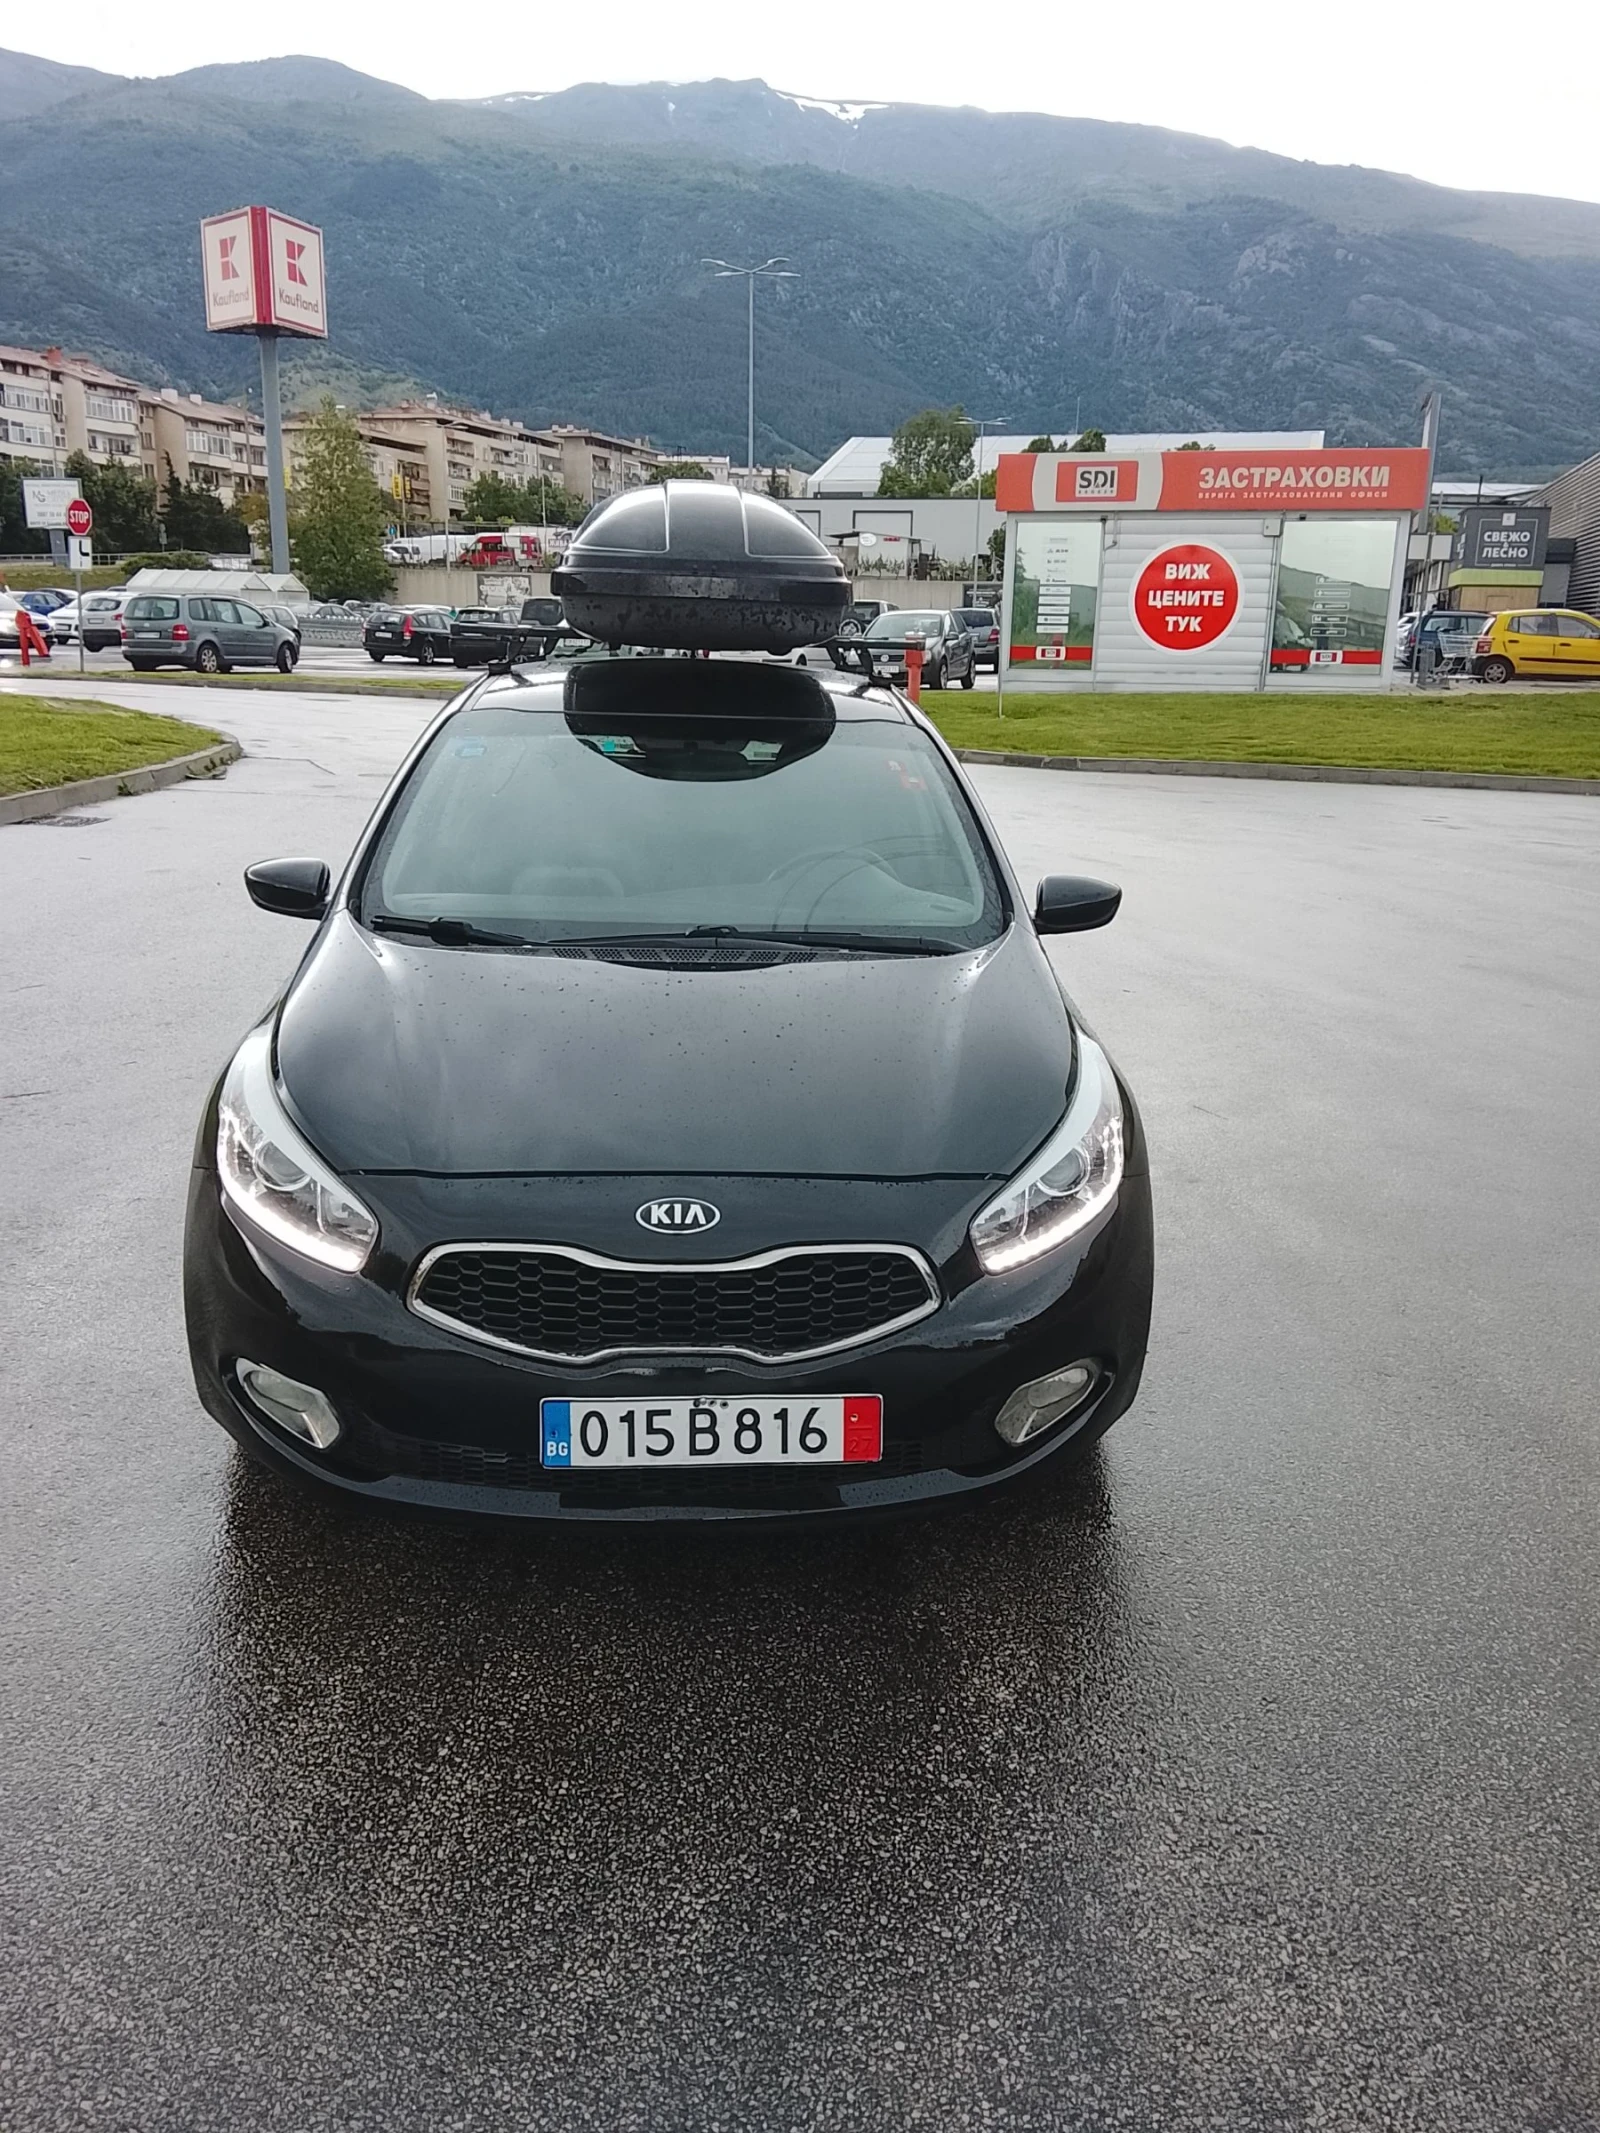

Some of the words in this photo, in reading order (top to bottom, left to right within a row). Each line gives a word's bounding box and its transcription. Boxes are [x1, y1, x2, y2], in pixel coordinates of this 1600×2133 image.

[219, 235, 240, 281] K
[285, 239, 308, 287] K
[212, 287, 250, 307] Kaufland
[278, 287, 320, 313] Kaufland
[1079, 470, 1115, 488] SDI
[1198, 466, 1390, 489] ЗАСТРАХОВКИ
[69, 510, 89, 524] STOP
[1483, 531, 1531, 543] СВЕЖО
[1481, 547, 1529, 559] ЛЕСНО
[1164, 562, 1211, 581] ВИЖ
[1147, 590, 1225, 610] ЦЕНИТЕ
[1165, 615, 1203, 633] ТУК
[650, 1203, 707, 1225] KIA
[546, 1441, 568, 1457] BG
